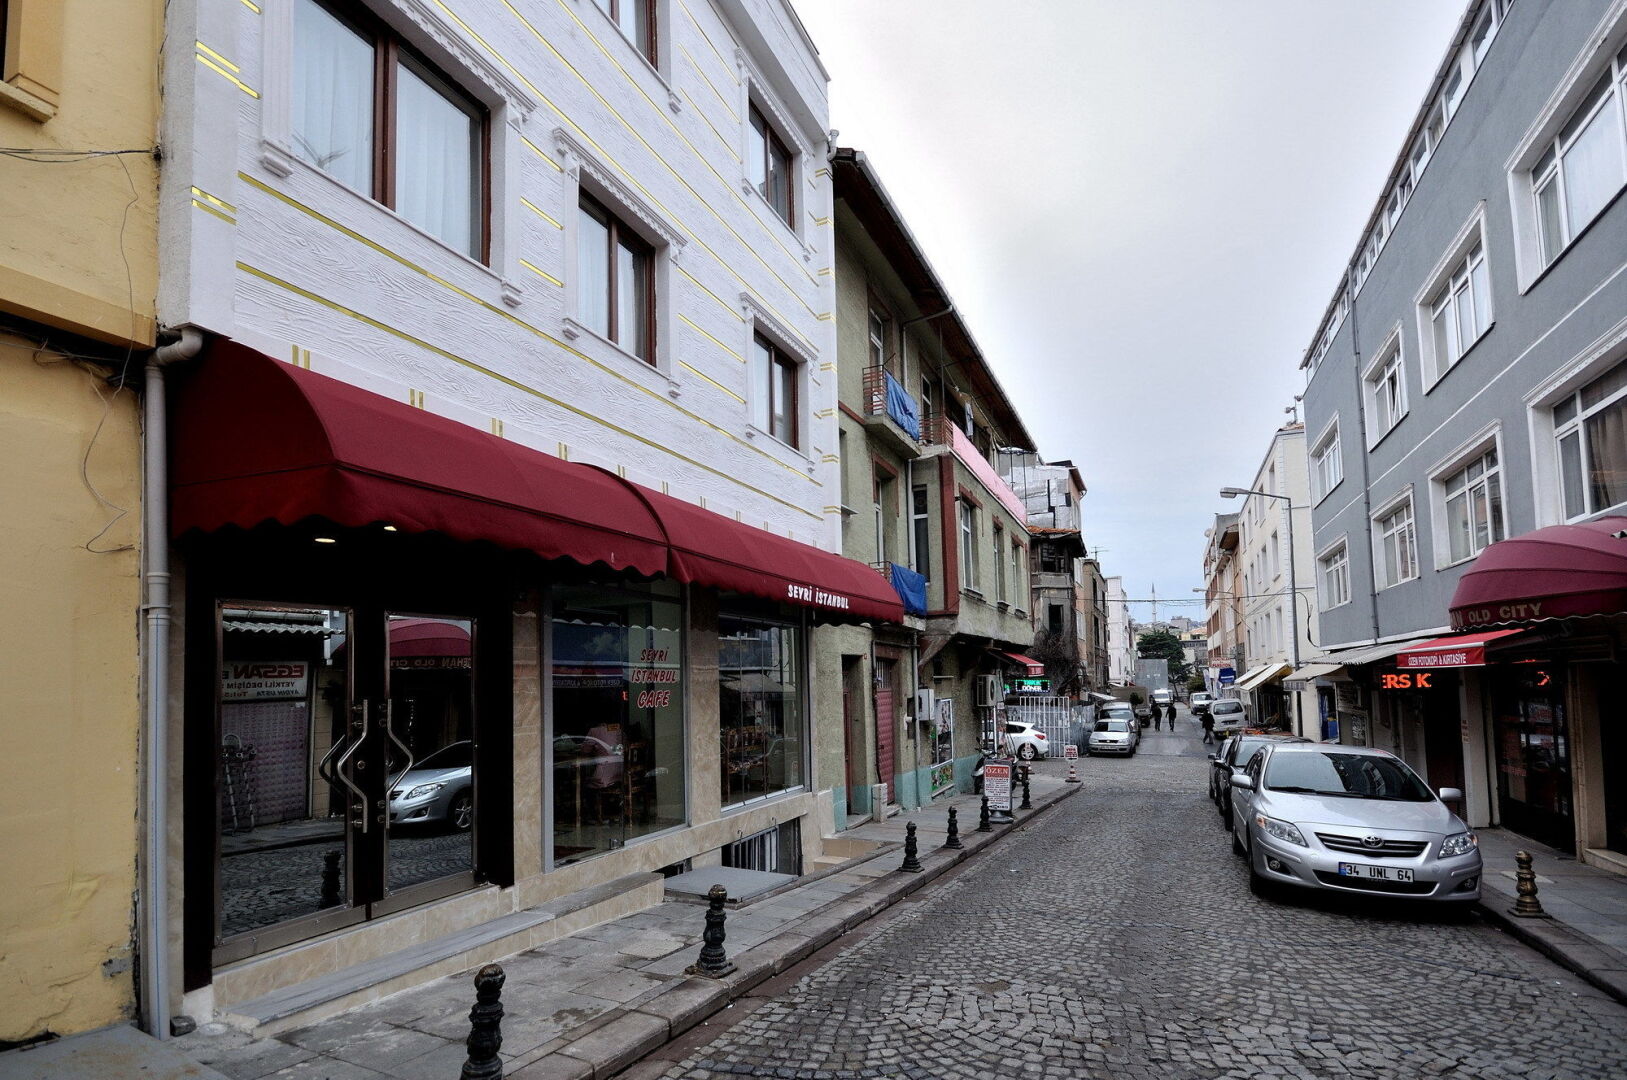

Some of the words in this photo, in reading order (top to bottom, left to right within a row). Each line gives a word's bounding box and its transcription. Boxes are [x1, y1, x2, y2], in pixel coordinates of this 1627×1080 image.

[788, 584, 812, 602] SEYRİ
[815, 588, 849, 609] İSTANBUL
[1468, 609, 1491, 623] OLD
[1499, 602, 1541, 619] CITY
[641, 646, 670, 662] SEYRİ
[631, 666, 677, 684] İSTANBUL
[1416, 672, 1432, 688] K
[637, 690, 671, 708] CAFE
[986, 766, 1008, 775] ÖZEN
[1346, 864, 1359, 876] 34
[1369, 867, 1390, 879] UNL
[1397, 869, 1411, 882] 64
